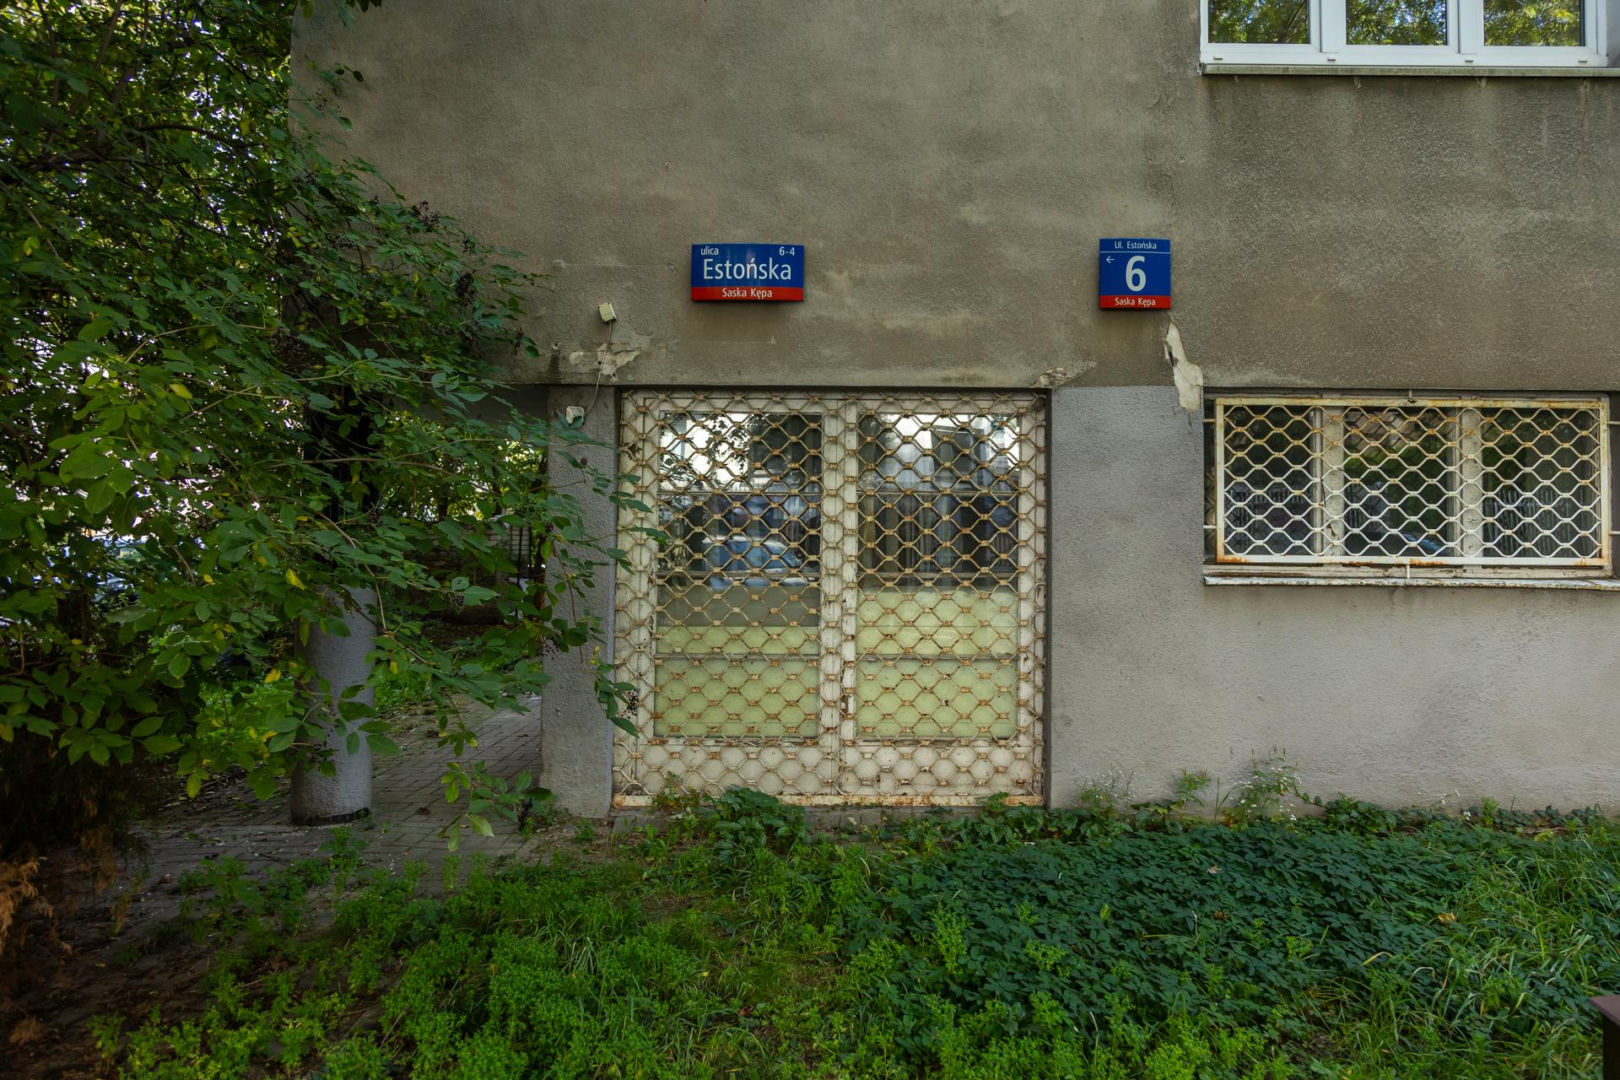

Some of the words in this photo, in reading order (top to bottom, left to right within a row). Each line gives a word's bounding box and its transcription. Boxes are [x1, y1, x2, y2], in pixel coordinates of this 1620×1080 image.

[700, 245, 719, 256] ulica
[1126, 241, 1157, 249] Estońska
[703, 257, 792, 280] Estońska
[1125, 255, 1147, 292] 6
[722, 287, 747, 298] Saska
[750, 287, 773, 299] Kępa
[1114, 297, 1136, 306] Saska
[1137, 297, 1156, 307] Kępa
